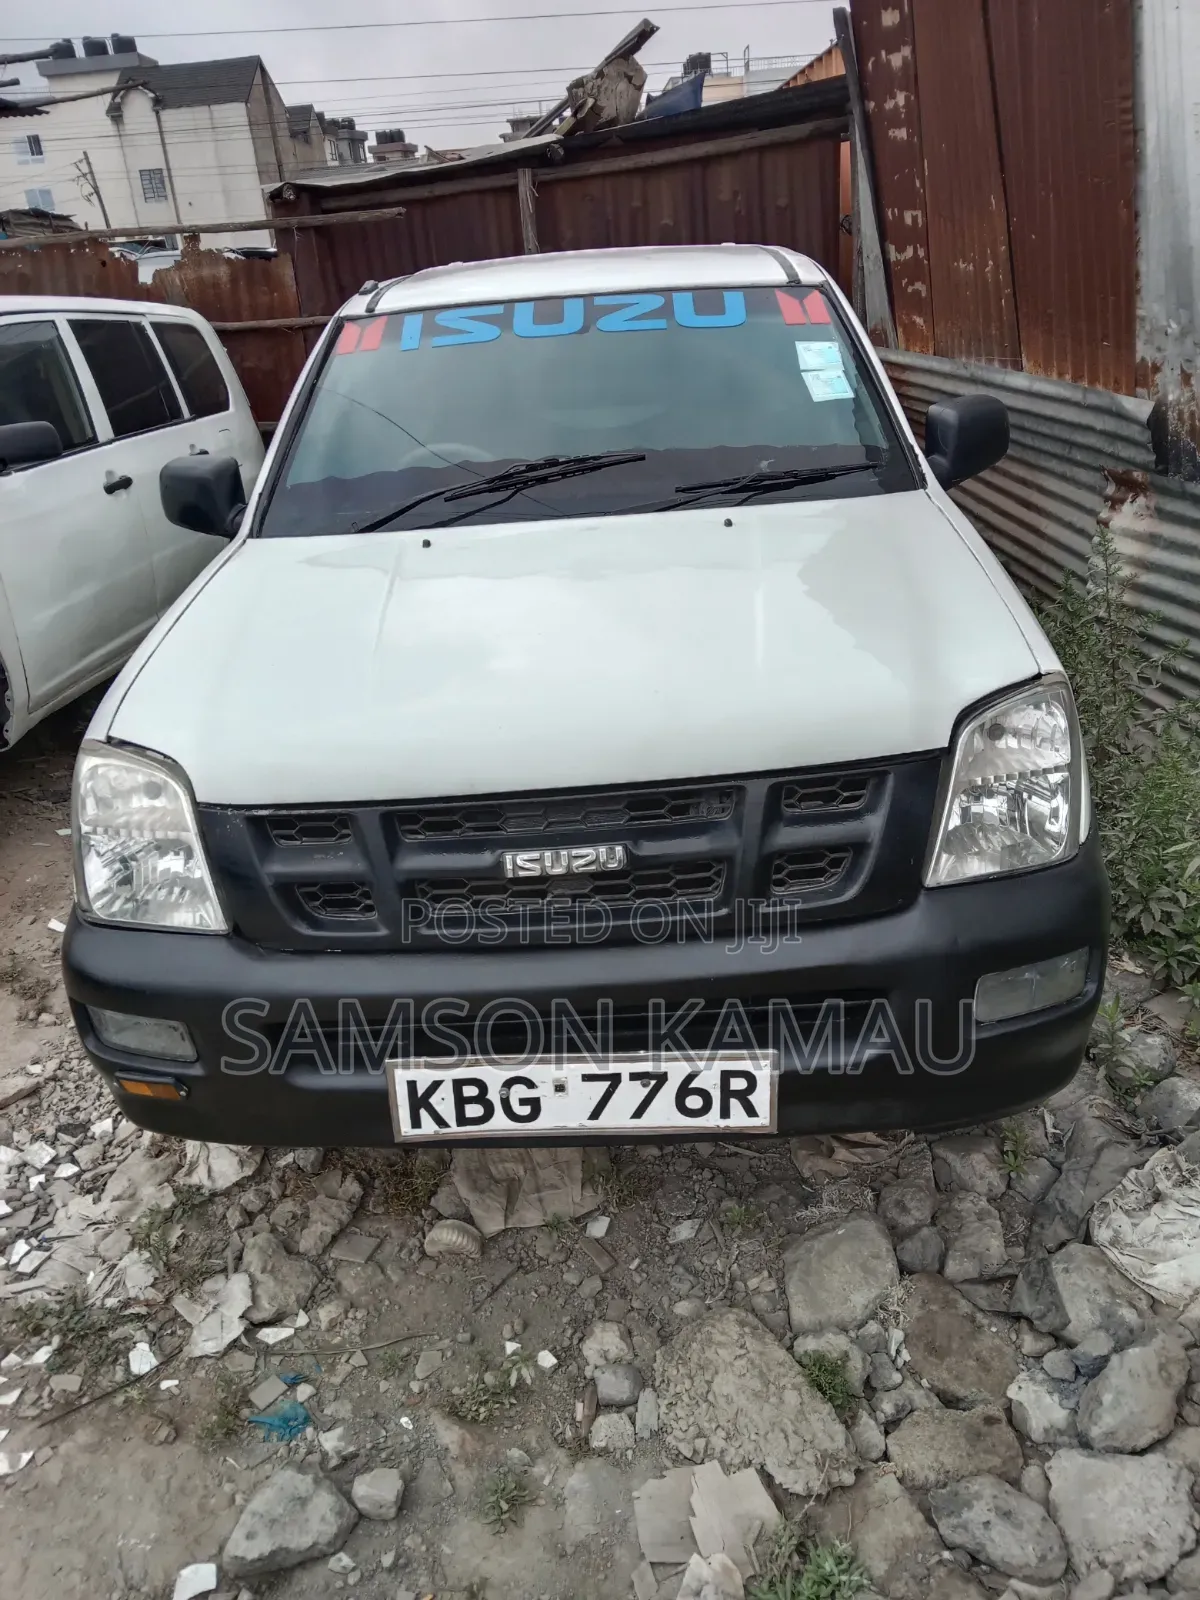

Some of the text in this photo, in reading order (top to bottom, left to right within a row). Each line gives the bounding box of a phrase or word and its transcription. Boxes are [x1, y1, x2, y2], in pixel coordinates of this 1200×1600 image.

[400, 291, 747, 351] ISUZU
[504, 844, 628, 878] ISUZU
[405, 1069, 760, 1129] KBG 776R
